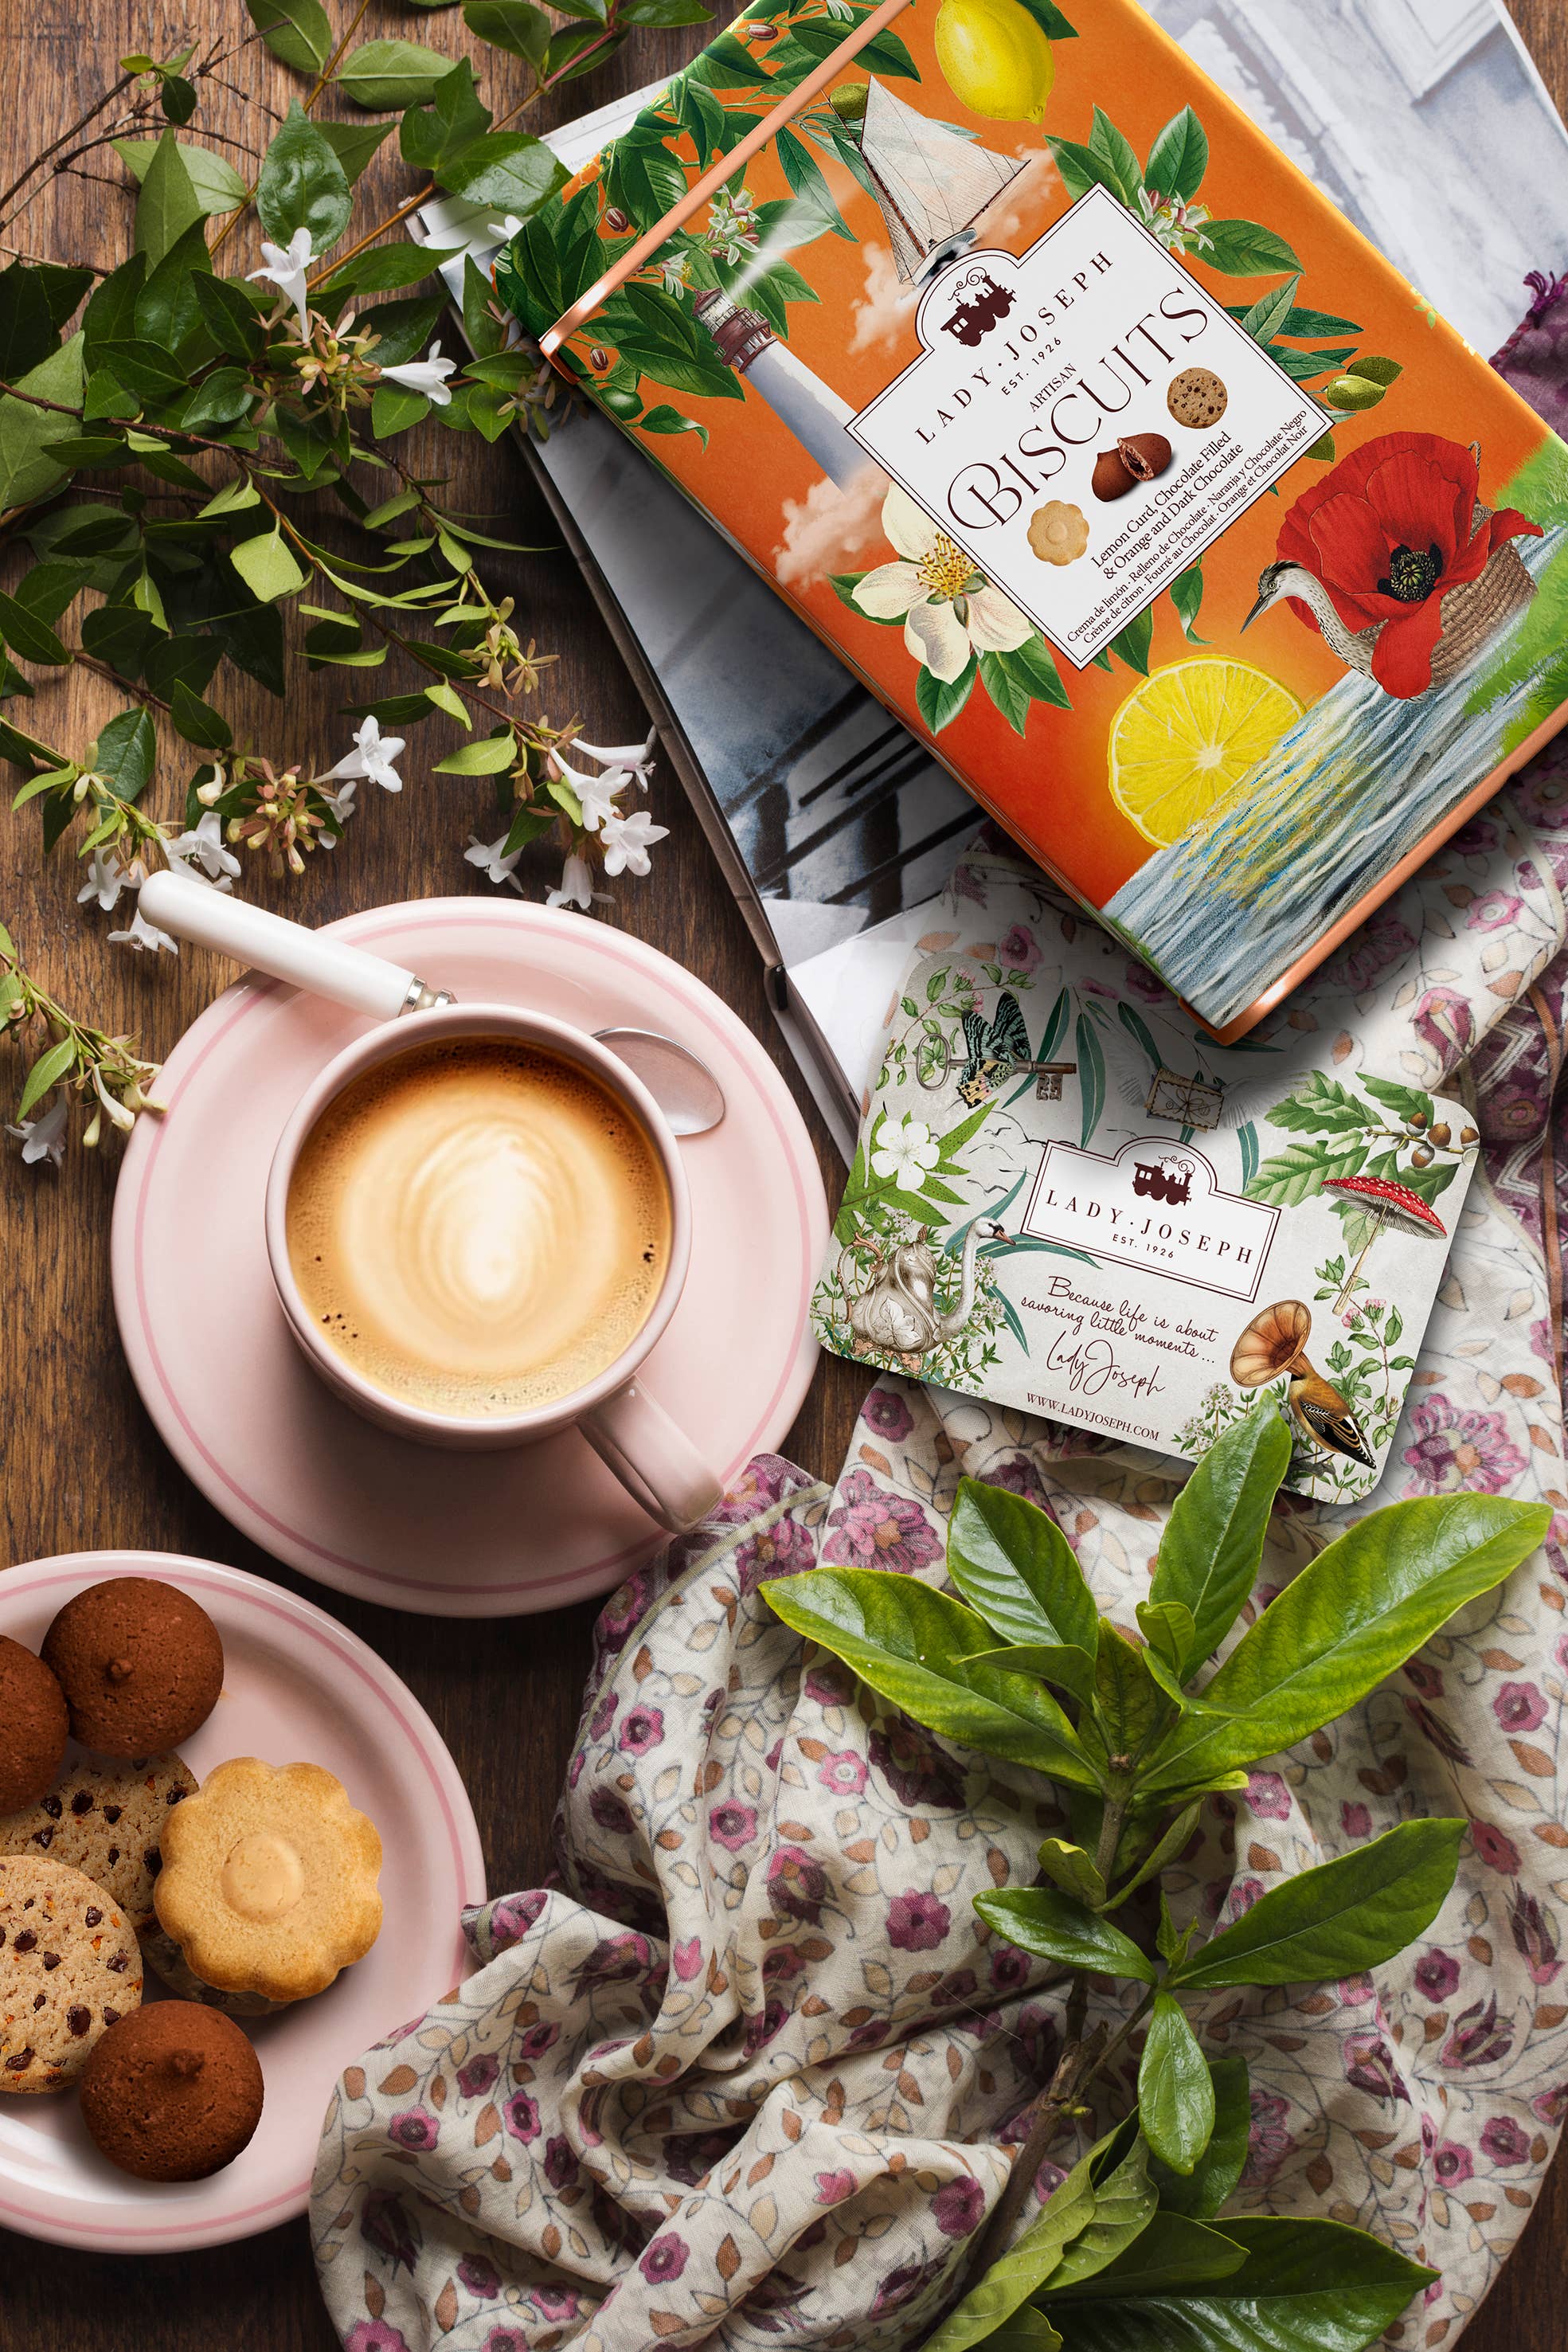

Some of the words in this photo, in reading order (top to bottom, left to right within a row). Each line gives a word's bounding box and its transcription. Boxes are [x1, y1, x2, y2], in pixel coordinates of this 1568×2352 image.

[915, 367, 991, 444] LADY
[1004, 251, 1112, 361] JOSEPH
[1001, 372, 1029, 395] EST.
[1032, 338, 1061, 365] 1926
[948, 288, 1207, 529] BISCUITS
[1030, 363, 1077, 413] ARTISAN
[1067, 616, 1096, 642] Crema
[1094, 606, 1105, 617] de
[1101, 585, 1128, 608] limón
[1128, 554, 1159, 582] Relleno
[1159, 543, 1170, 554] de
[1168, 507, 1207, 544] Chocolate
[1207, 475, 1241, 505] Naranja
[1238, 468, 1247, 479] y
[1244, 433, 1283, 470] Chocolate
[1280, 410, 1307, 435] Negro
[1084, 617, 1112, 643] Crème
[1110, 608, 1121, 619] de
[1121, 586, 1144, 609] citron
[1144, 556, 1173, 584] Fourré
[1172, 548, 1183, 559] au
[1181, 515, 1217, 548] Chocolat
[1218, 484, 1248, 512] Orange
[1245, 476, 1257, 486] et
[1254, 444, 1290, 477] Chocolat
[1286, 426, 1307, 446] Noir
[1091, 533, 1130, 568] Lemon
[1127, 504, 1158, 533] Curd,
[1155, 460, 1204, 506] Chocolate
[1199, 431, 1231, 462] Filled
[1103, 567, 1117, 579] &
[1114, 533, 1152, 568] Orange
[1151, 512, 1171, 535] and
[1167, 490, 1197, 517] Dark
[1194, 444, 1243, 491] Chocolate
[1046, 1190, 1123, 1223] LADY
[1140, 1219, 1252, 1263] JOSEPH
[1112, 1234, 1137, 1247] EST.
[1147, 1244, 1173, 1258] 1926
[1021, 1297, 1084, 1336] savoring
[1090, 1311, 1127, 1336] little
[1047, 1276, 1114, 1314] Because
[1119, 1300, 1148, 1332] life
[1154, 1317, 1170, 1329] is
[1175, 1319, 1218, 1342] about
[1027, 1392, 1159, 1441] WWW.LADYJOSEPH.COM
